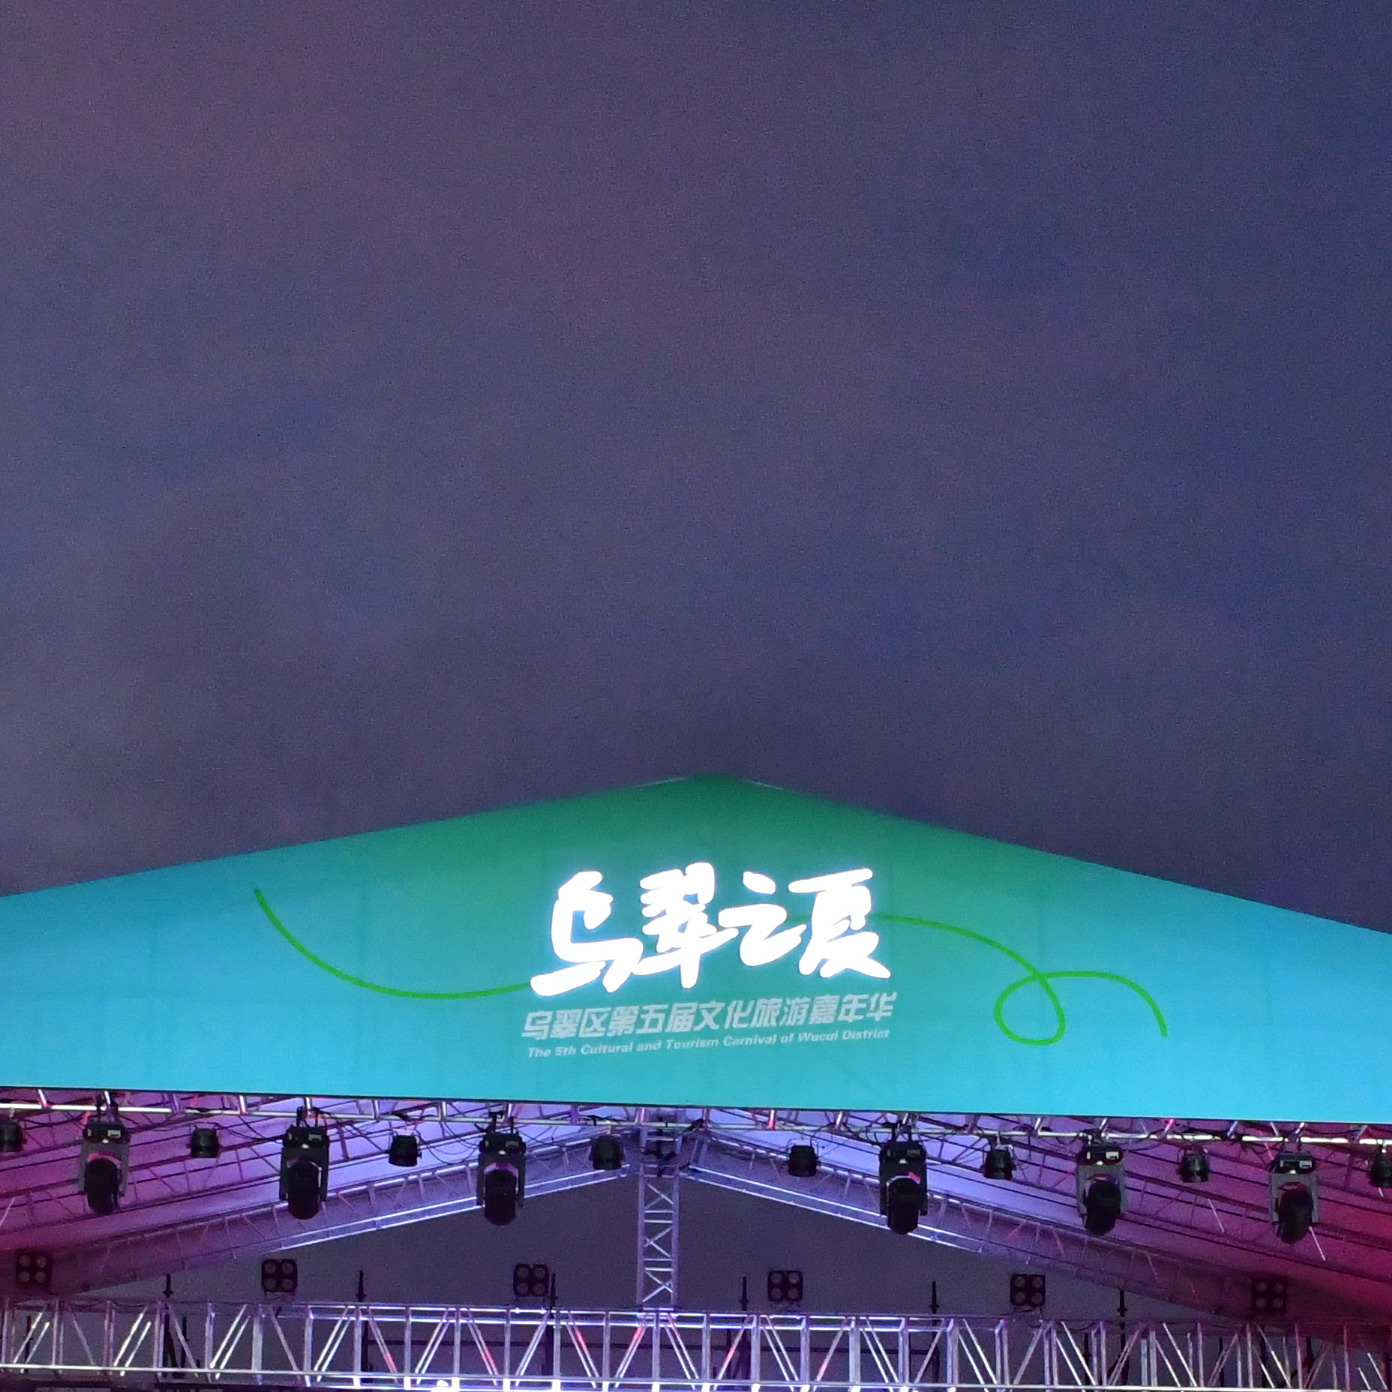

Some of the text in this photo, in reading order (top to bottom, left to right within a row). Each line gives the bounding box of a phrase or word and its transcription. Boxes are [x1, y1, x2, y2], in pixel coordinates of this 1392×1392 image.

[530, 861, 891, 996] 乌翠之夏
[521, 992, 898, 1040] 乌翠区第五届文化旅游嘉年华
[528, 1047, 551, 1058] The
[555, 1046, 576, 1056] 5th
[581, 1042, 633, 1055] Cultural
[637, 1040, 662, 1051] and
[666, 1037, 719, 1049] Tourism
[723, 1034, 777, 1046] Carnival
[781, 1032, 794, 1043] of
[842, 1028, 890, 1040] District
